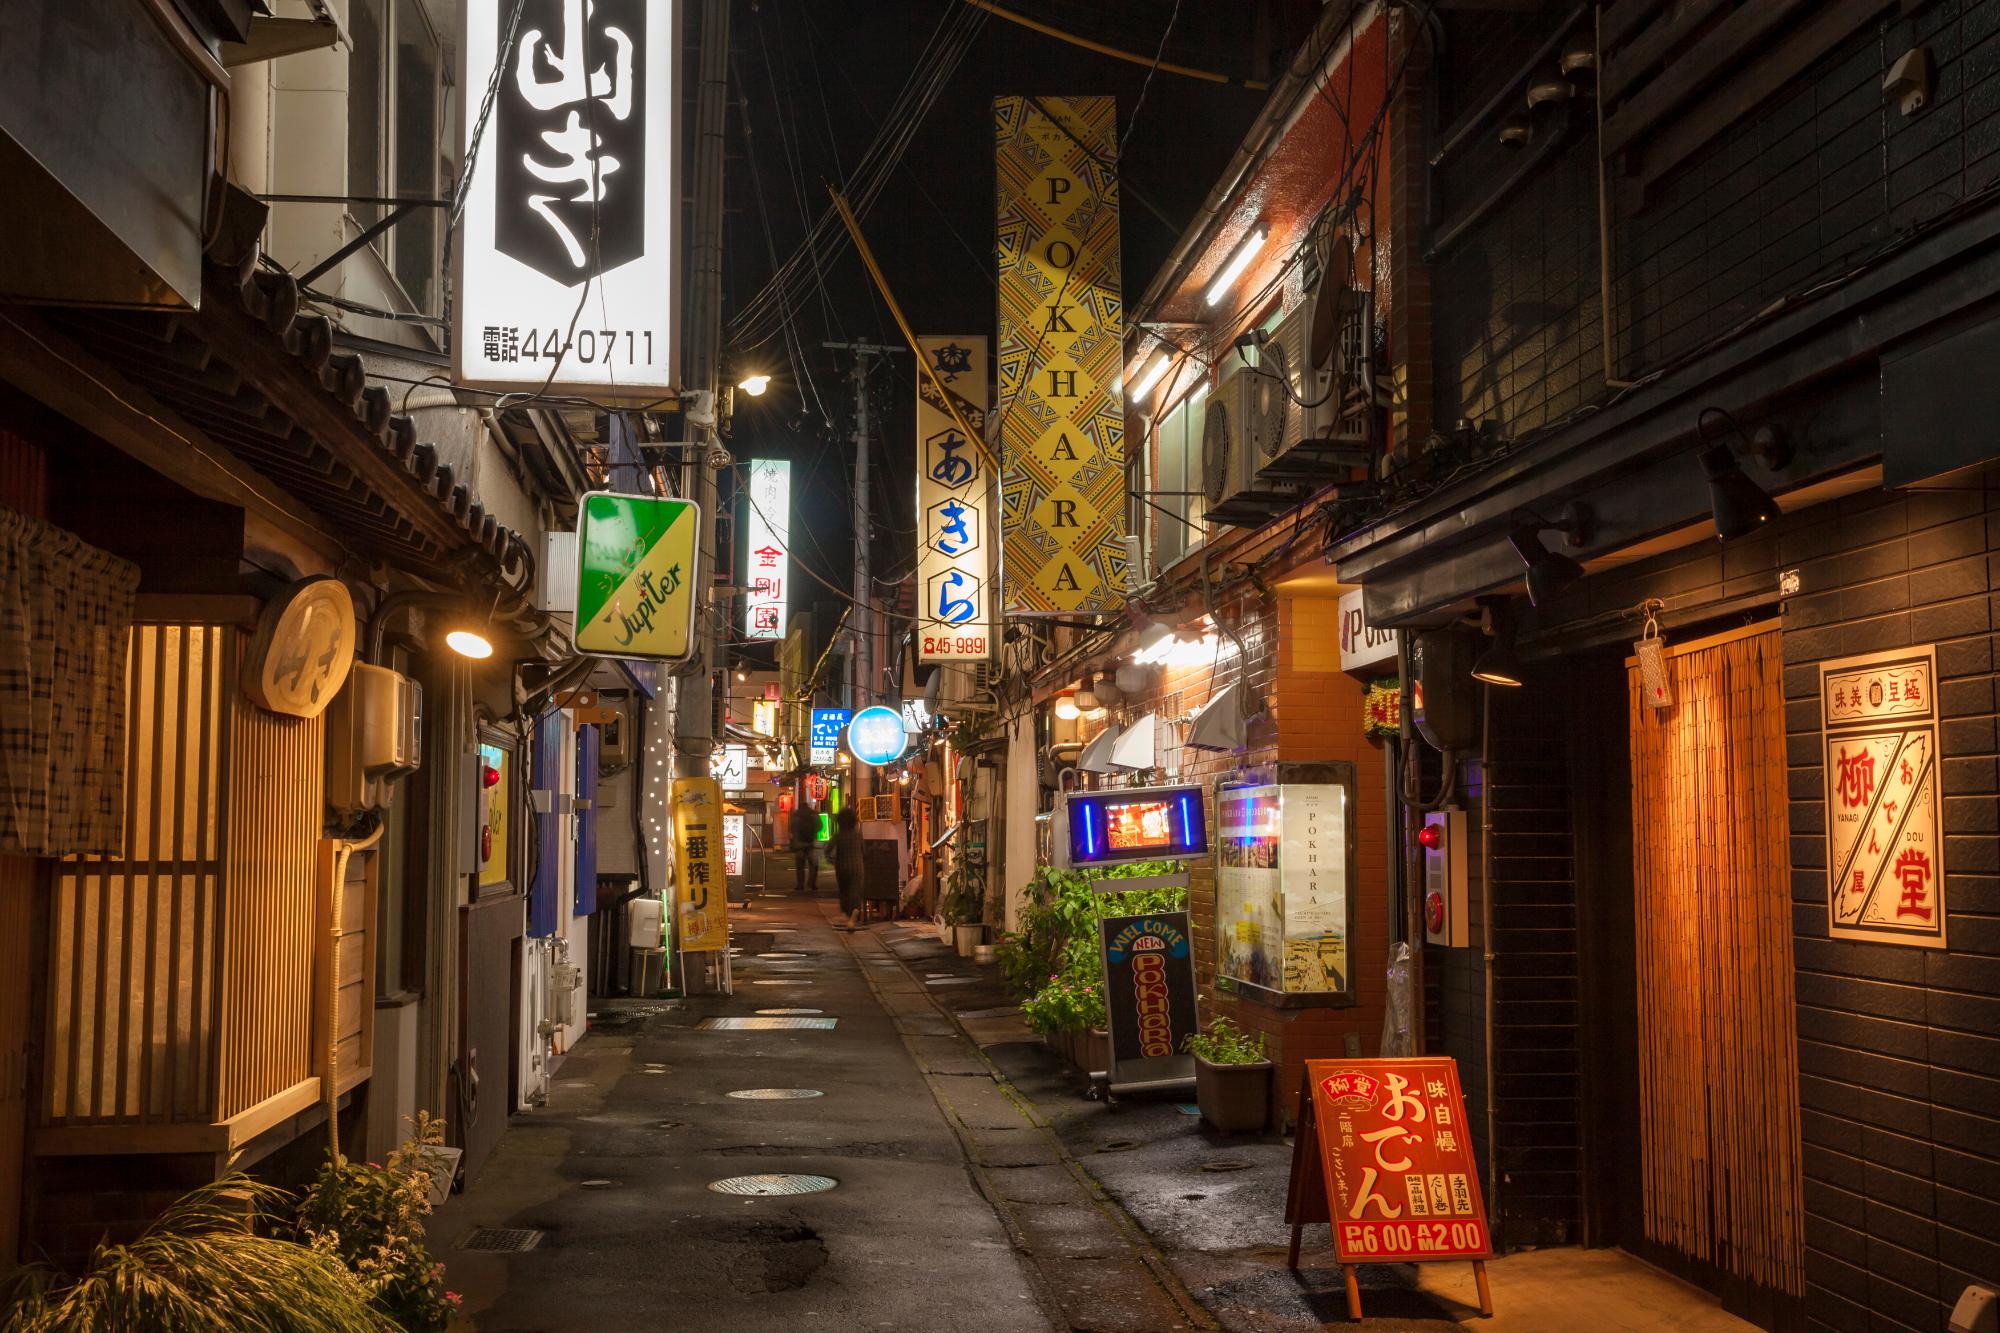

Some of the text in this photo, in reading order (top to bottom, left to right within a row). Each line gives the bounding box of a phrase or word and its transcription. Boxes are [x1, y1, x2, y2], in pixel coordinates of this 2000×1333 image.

[1046, 177, 1082, 592] POKHARA
[932, 432, 975, 623] あきら
[603, 562, 681, 646] Jupiter
[1836, 745, 1875, 808] 柳
[1837, 813, 1859, 823] YANAGI
[1906, 831, 1924, 842] DOU
[685, 823, 711, 911] 一番搾り
[1308, 812, 1318, 905] POKHARA
[1894, 847, 1932, 921] 堂
[1136, 937, 1163, 950] NEW
[1327, 1076, 1373, 1096] 柳堂
[1427, 1081, 1457, 1152] 味自慢
[1349, 1072, 1426, 1220] おでん
[1453, 1176, 1470, 1211] 手羽先
